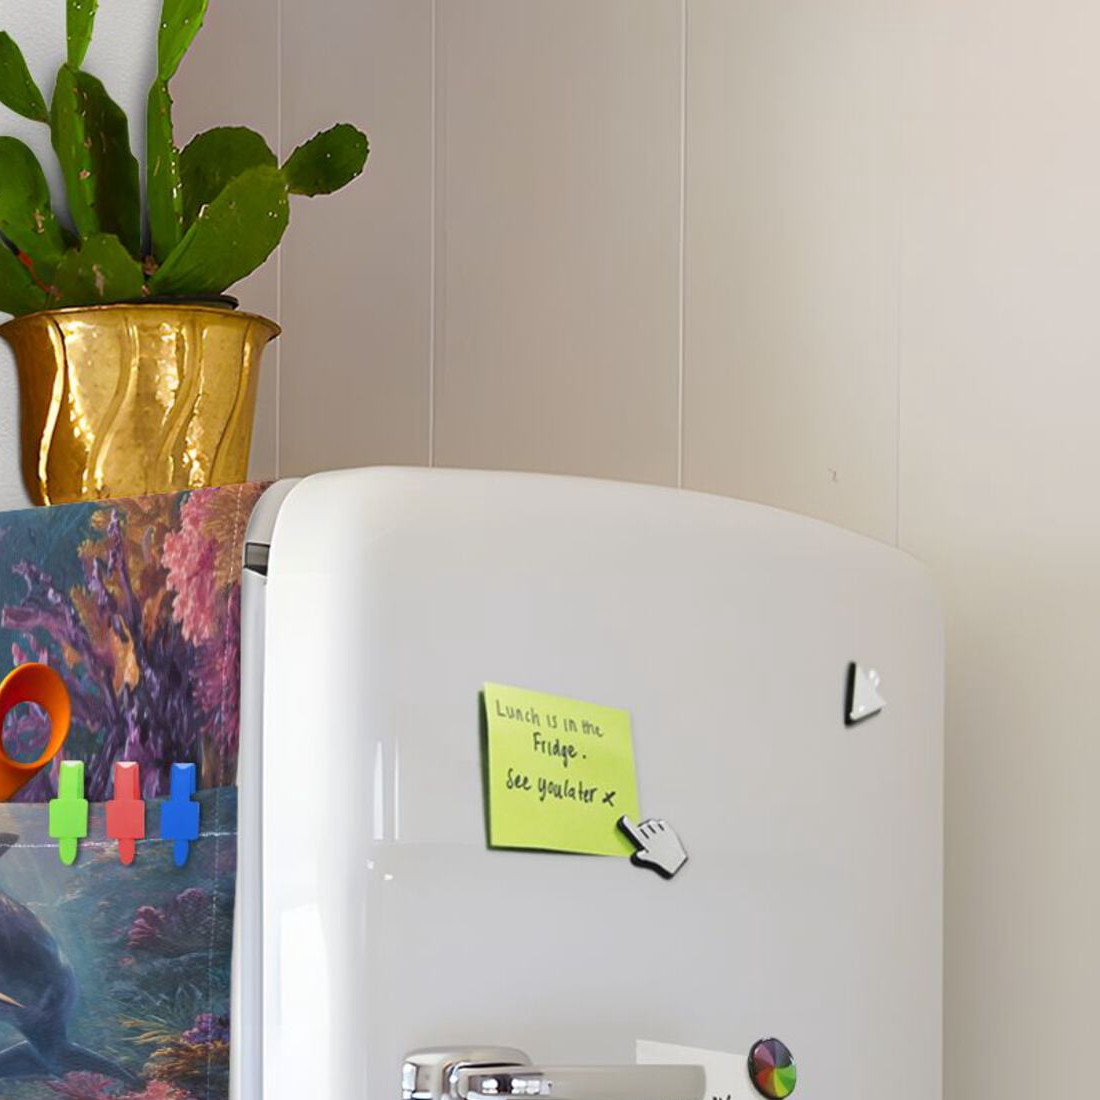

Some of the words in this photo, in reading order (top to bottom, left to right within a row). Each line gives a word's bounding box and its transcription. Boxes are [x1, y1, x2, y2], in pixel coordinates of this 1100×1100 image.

[495, 699, 540, 727] Lunch
[546, 714, 558, 729] is
[564, 717, 578, 733] in
[581, 719, 604, 738] the
[506, 768, 532, 791] See
